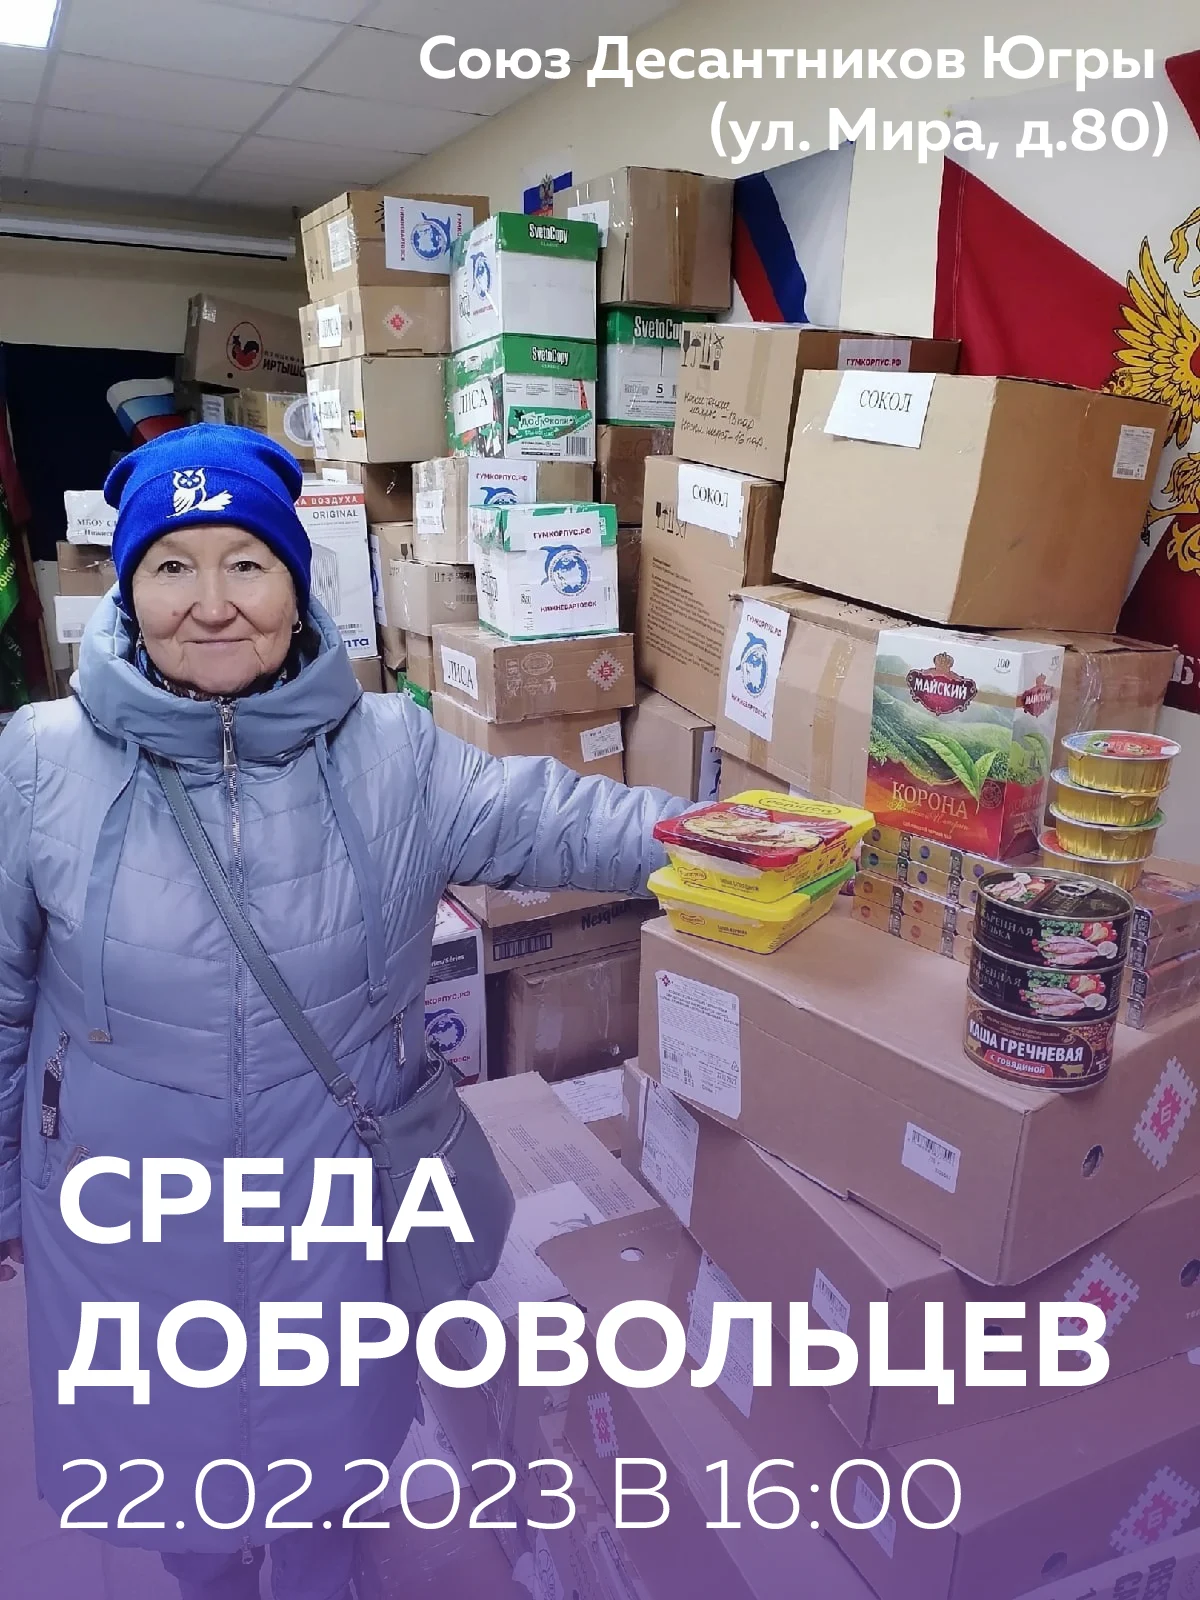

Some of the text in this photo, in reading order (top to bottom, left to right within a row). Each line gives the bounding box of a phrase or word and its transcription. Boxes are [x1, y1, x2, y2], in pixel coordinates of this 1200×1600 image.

[528, 223, 568, 244] SvetoCopy
[531, 345, 569, 366] SvetoCopy
[656, 383, 664, 394] 5
[459, 387, 488, 415] ЛИСА
[859, 388, 914, 413] СОКОЛ
[311, 495, 358, 505] ВОЗДУХА
[692, 484, 730, 508] СОКОЛ
[312, 509, 359, 520] ORIGINAL
[532, 527, 593, 540] ГУМКОРПУС.РФ
[447, 664, 475, 691] ЛИСА
[913, 677, 968, 700] МАЙСКИЙ
[892, 780, 969, 820] КОРОНА
[969, 1018, 998, 1049] КАША
[1000, 1037, 1084, 1063] ГРЕЧНЕВАЯ
[996, 1056, 1046, 1074] говядиной
